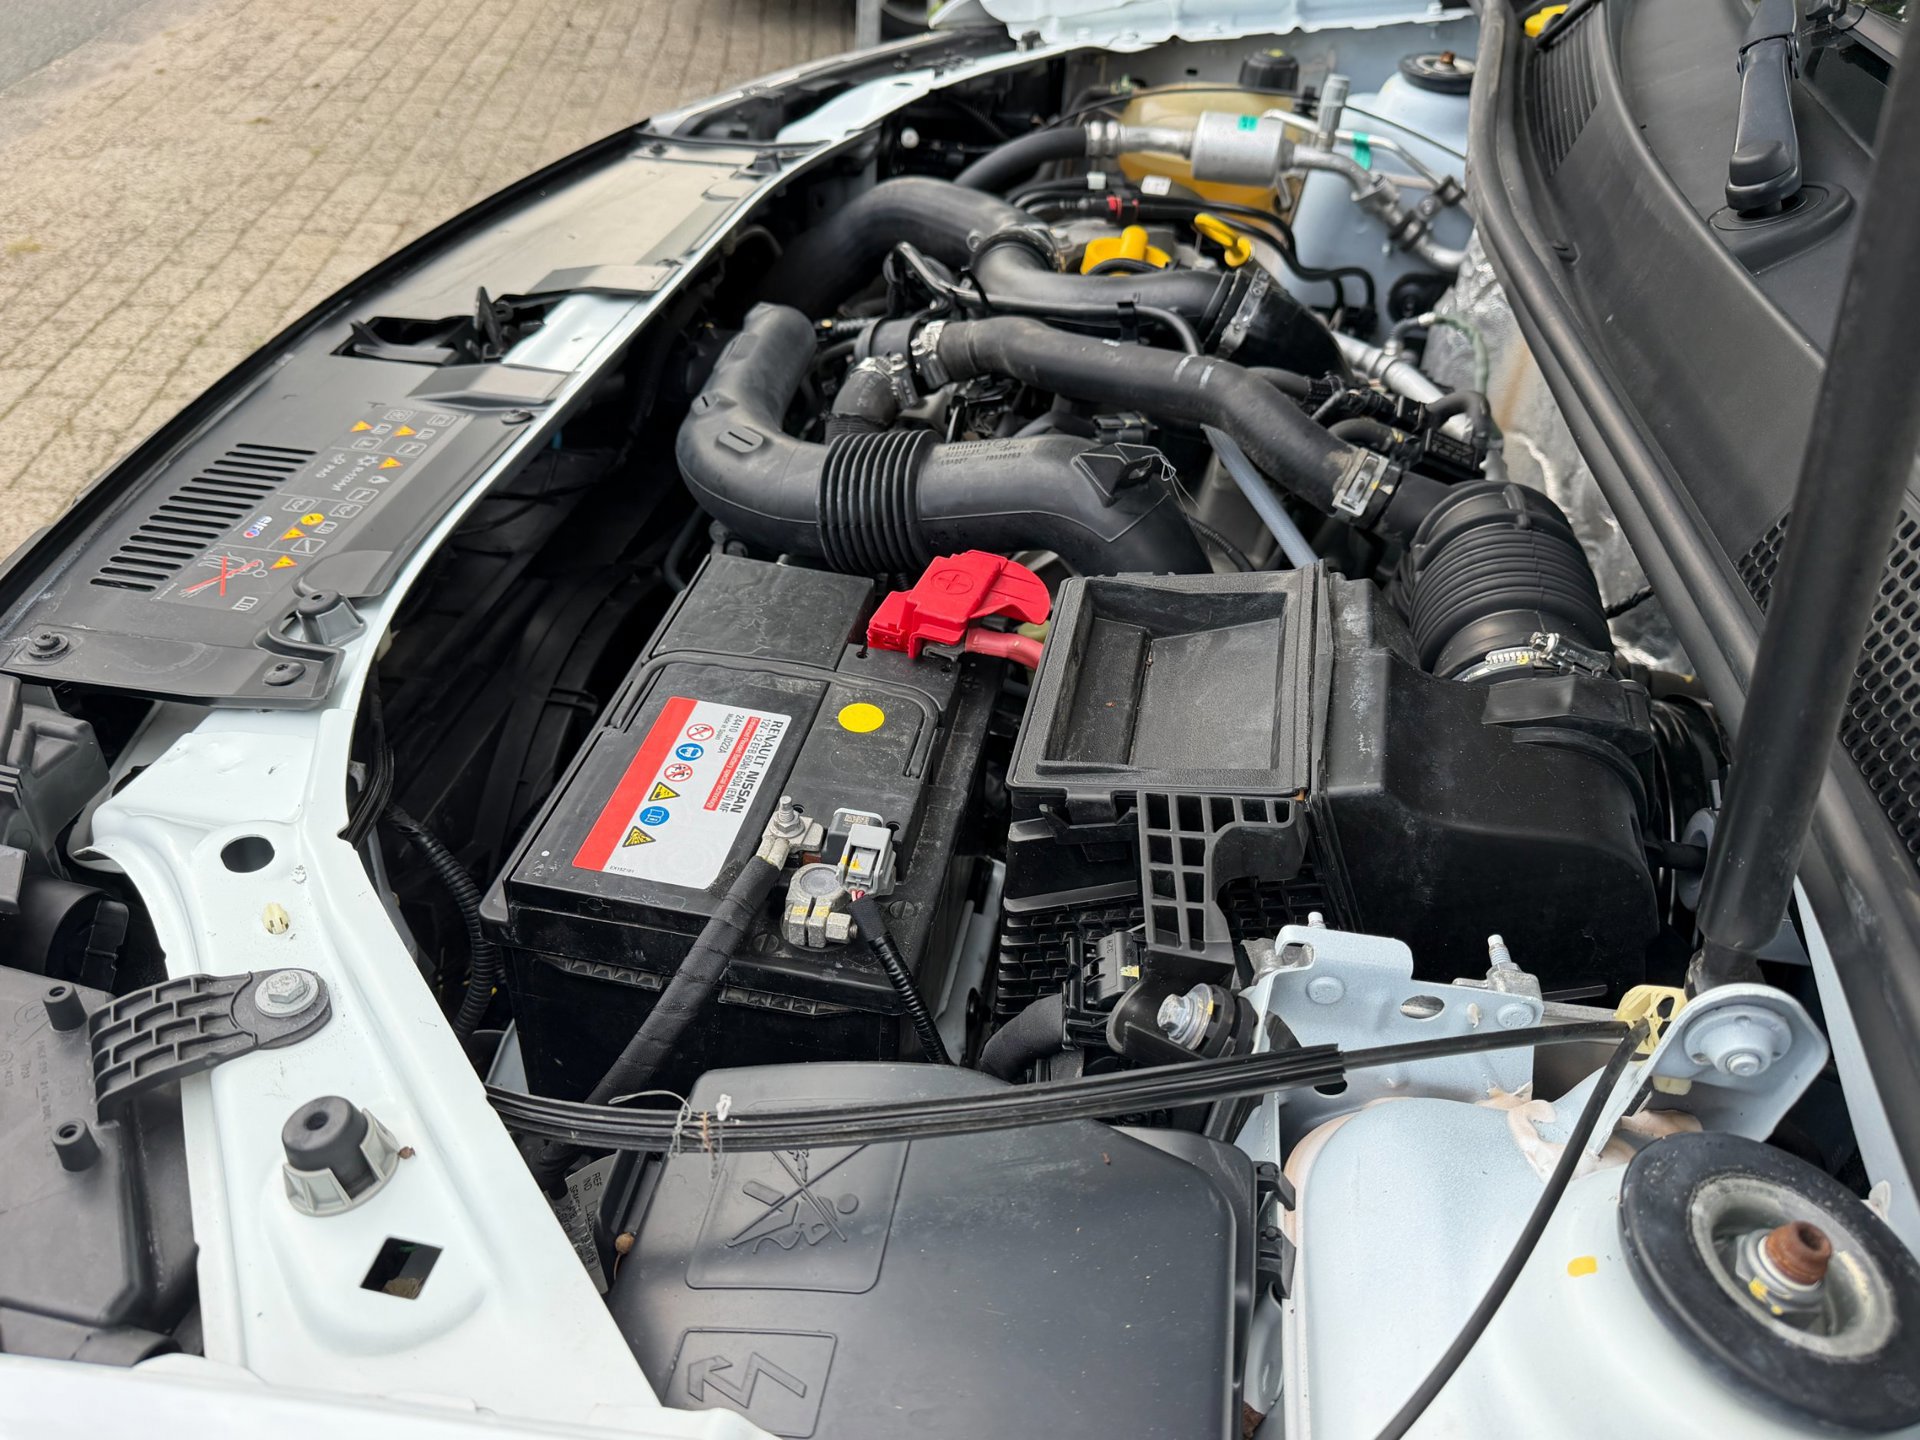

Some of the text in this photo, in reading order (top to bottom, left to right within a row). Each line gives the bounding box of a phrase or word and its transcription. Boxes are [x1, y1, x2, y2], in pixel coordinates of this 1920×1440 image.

[729, 715, 744, 732] 24410
[760, 719, 771, 729] 12V
[747, 742, 760, 754] EFB
[731, 721, 783, 813] RENAULT NISSAN
[740, 754, 753, 769] 60Ah
[731, 771, 746, 786] 640A
[719, 802, 731, 812] MF
